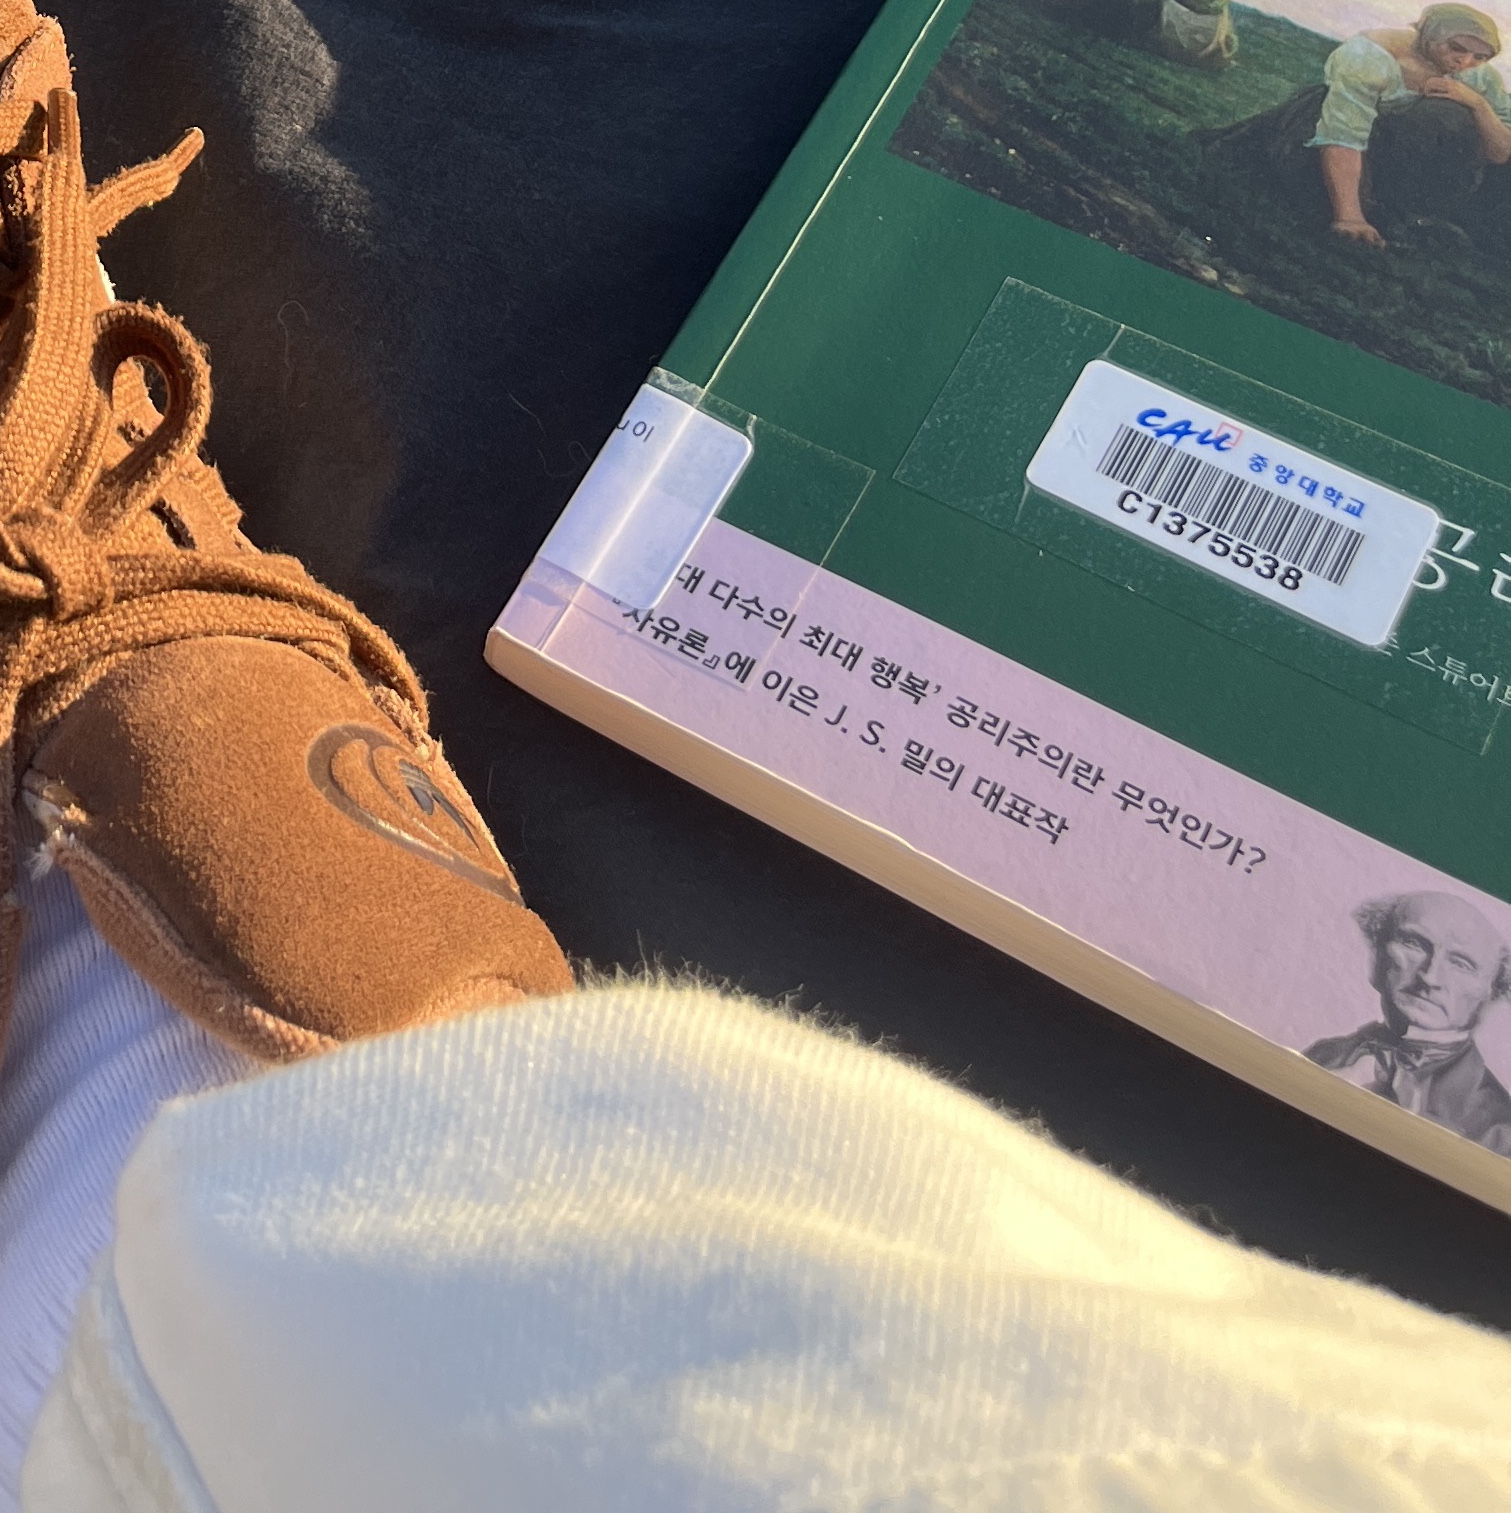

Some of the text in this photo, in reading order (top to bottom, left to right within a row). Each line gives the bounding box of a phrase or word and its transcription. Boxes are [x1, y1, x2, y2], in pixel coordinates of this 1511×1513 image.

[1116, 489, 1304, 591] C1375538
[1249, 452, 1366, 518] 중앙대학교
[708, 579, 797, 639] 다수의
[799, 625, 864, 672] 최대
[946, 695, 1106, 794] 공리주의란
[1111, 780, 1267, 874] 무엇인가?
[762, 670, 819, 717] 이은
[824, 704, 848, 734] J.
[859, 720, 886, 753] S.
[900, 738, 966, 791] 밀의
[970, 775, 1070, 845] 대표작
